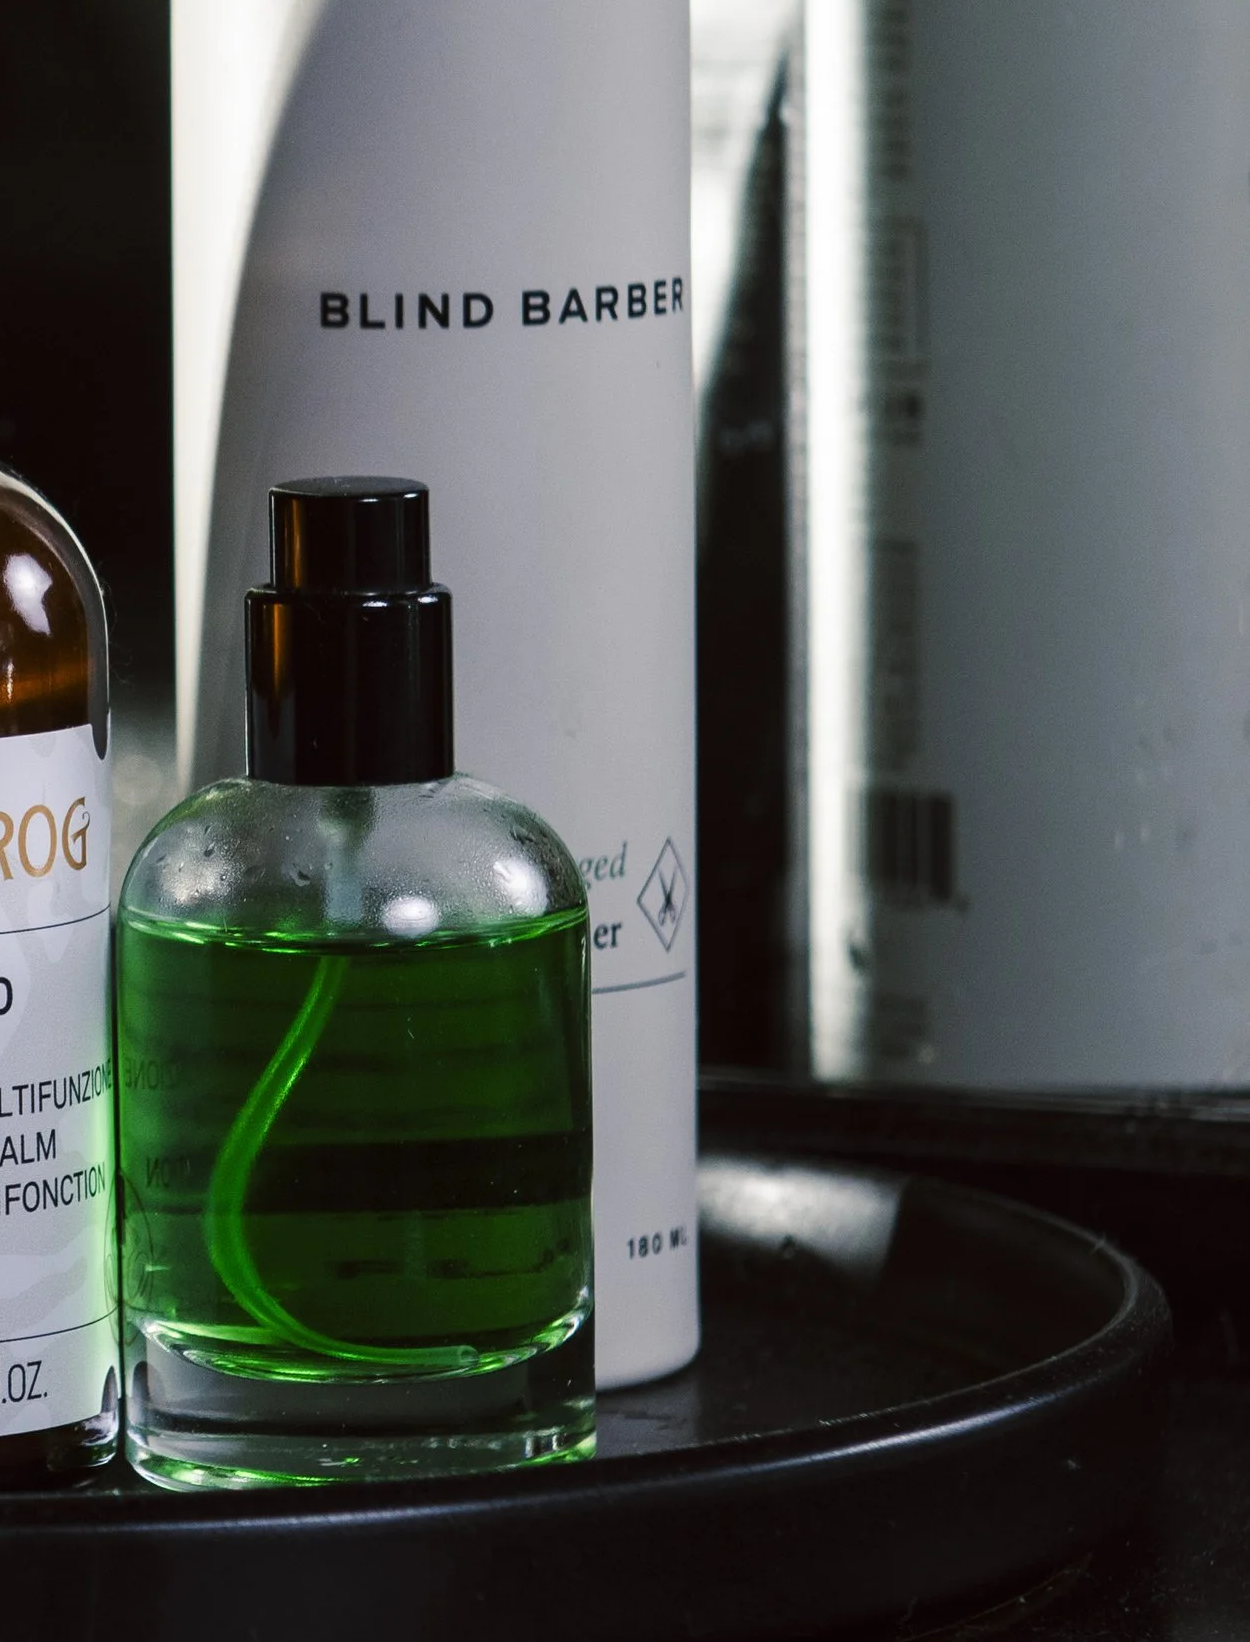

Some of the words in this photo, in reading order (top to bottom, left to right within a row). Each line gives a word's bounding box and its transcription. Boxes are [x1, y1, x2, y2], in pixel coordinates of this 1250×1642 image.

[320, 292, 494, 329] BLIND
[522, 277, 684, 326] BARBER
[626, 1230, 663, 1260] 180
